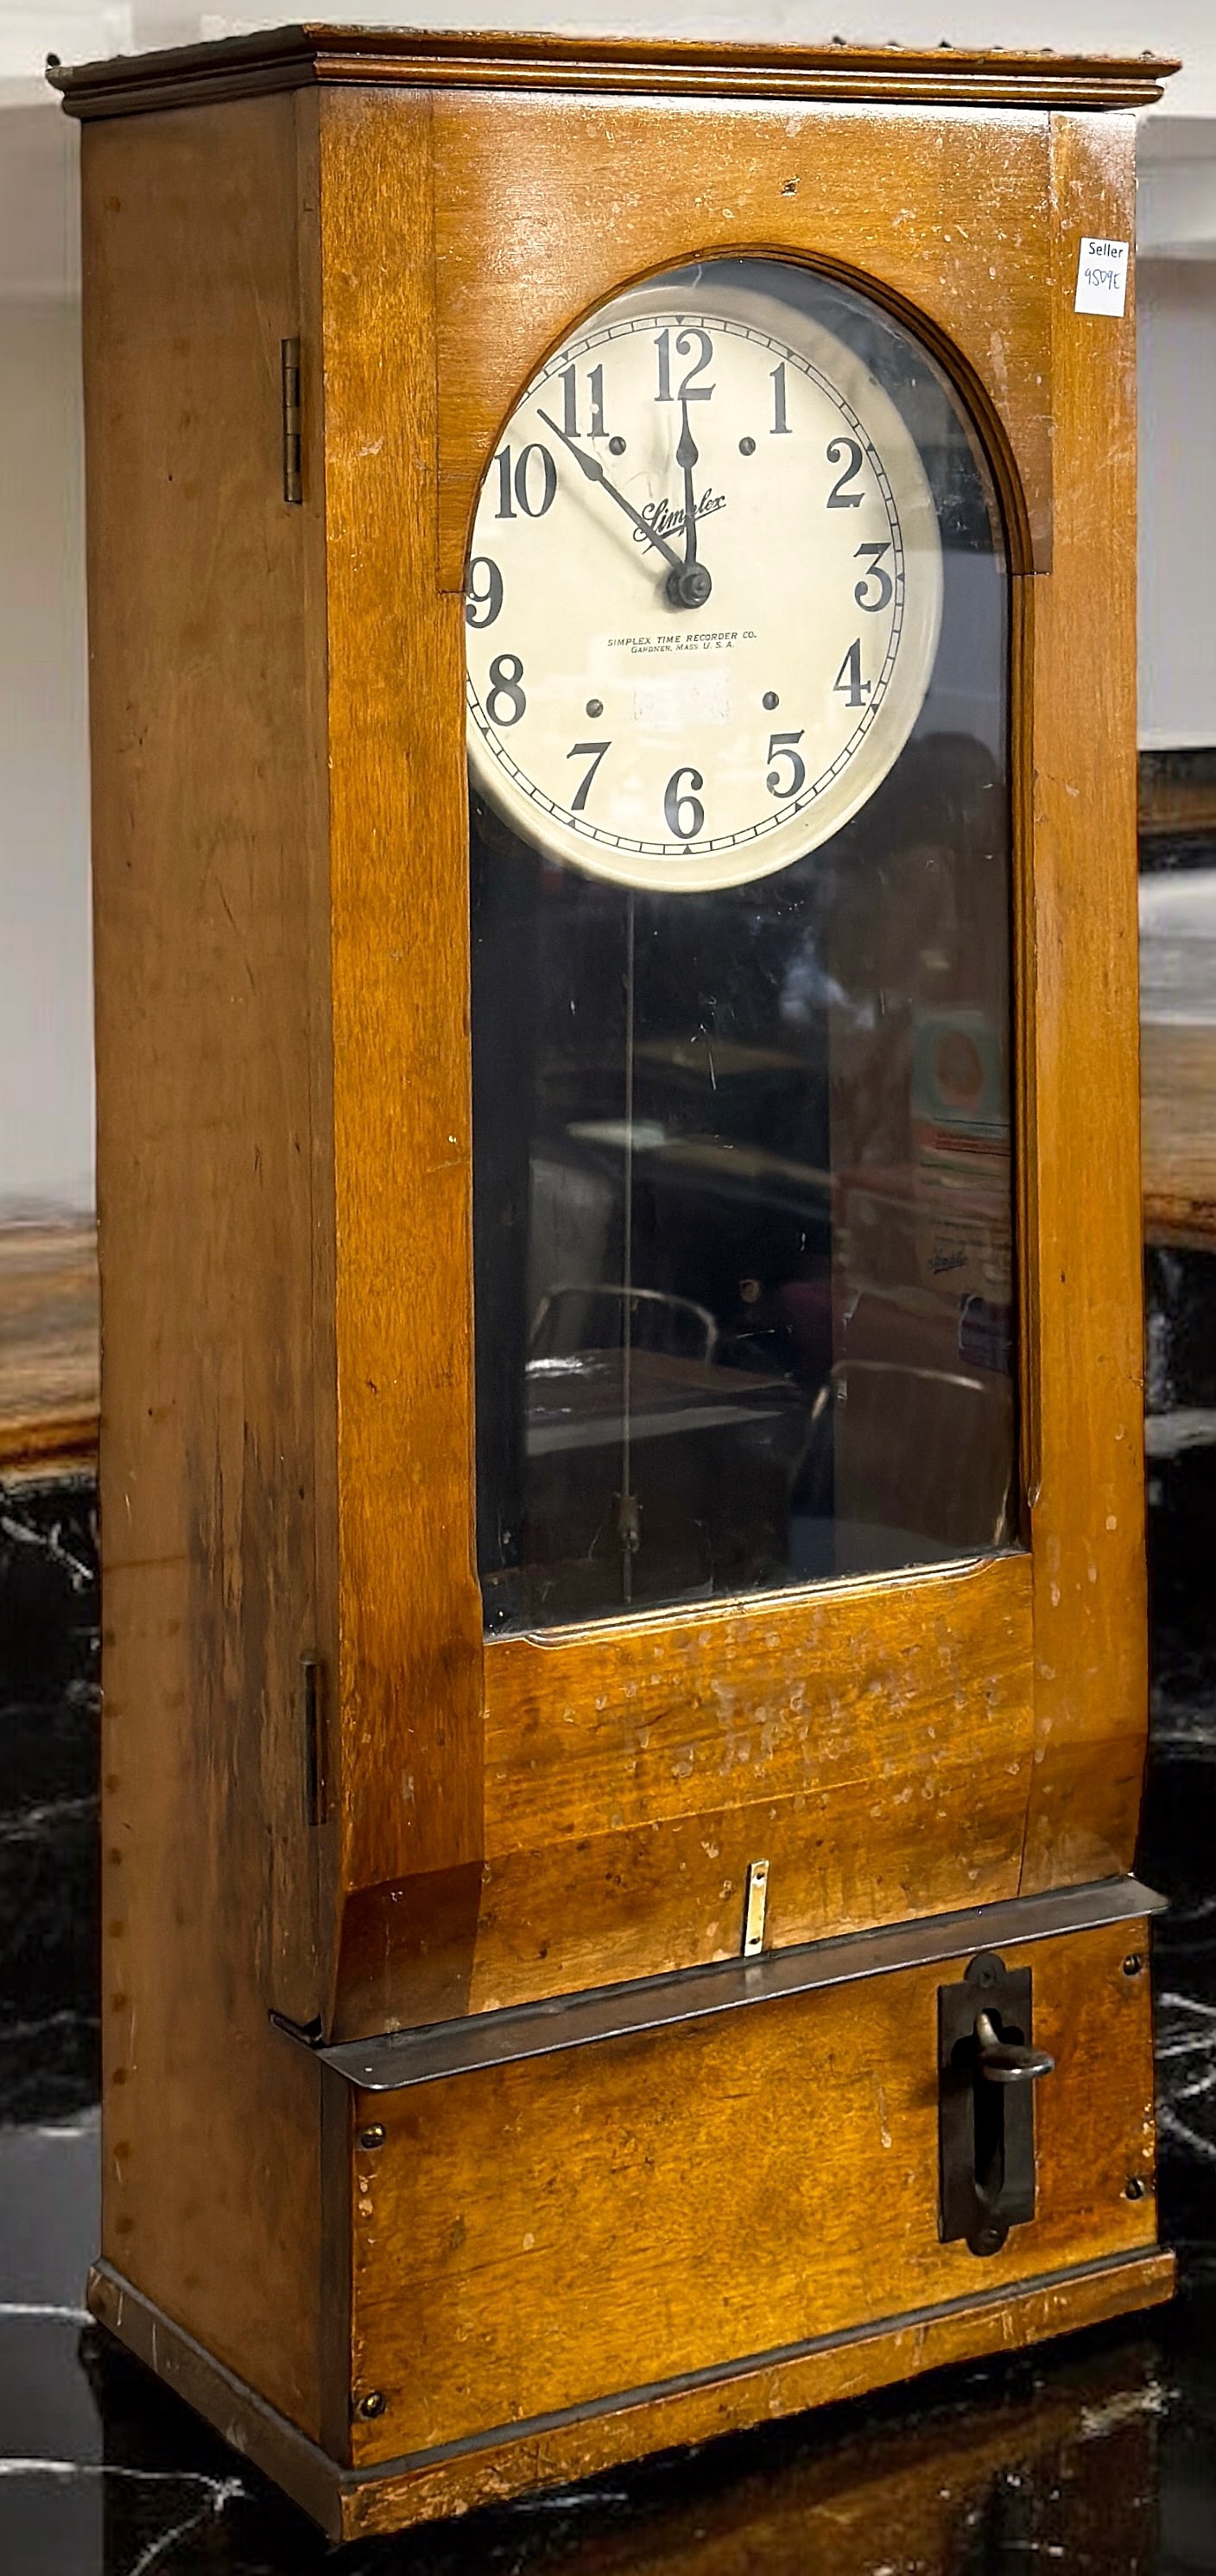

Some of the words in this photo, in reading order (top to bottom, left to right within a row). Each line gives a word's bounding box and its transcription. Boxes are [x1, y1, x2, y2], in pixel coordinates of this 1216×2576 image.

[1088, 242, 1124, 258] Seller
[558, 364, 610, 438] 11
[654, 328, 716, 402] 12
[770, 361, 793, 435] 1
[494, 443, 557, 519] 10
[826, 437, 865, 509] 2
[466, 556, 504, 629] 9
[852, 542, 893, 612] 3
[607, 637, 651, 647] SIMPLEX
[657, 635, 681, 644] TIME
[686, 631, 738, 643] RECORDER
[742, 631, 757, 639] CO.
[833, 638, 871, 707] 4
[485, 653, 527, 727] 8
[566, 741, 612, 811] 7
[766, 729, 806, 799] 5
[663, 767, 705, 840] 6
